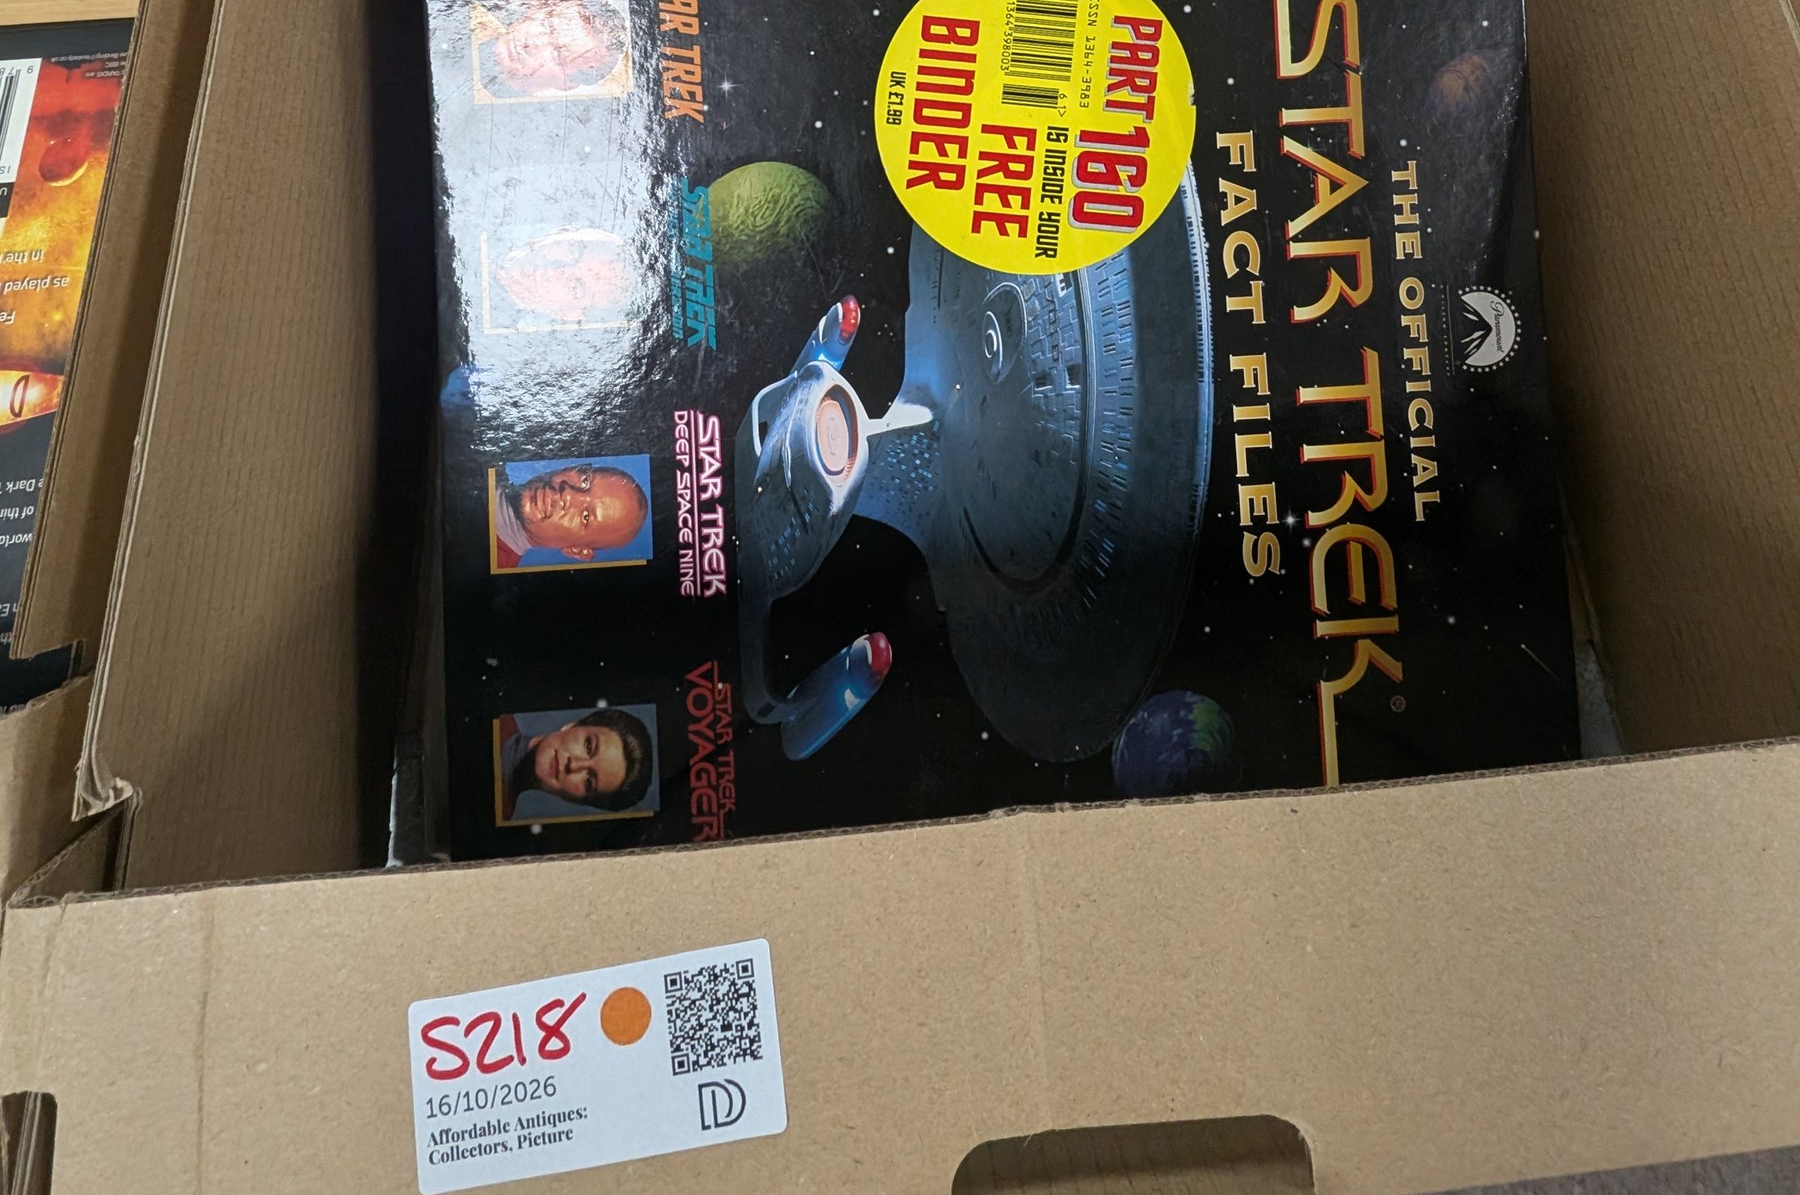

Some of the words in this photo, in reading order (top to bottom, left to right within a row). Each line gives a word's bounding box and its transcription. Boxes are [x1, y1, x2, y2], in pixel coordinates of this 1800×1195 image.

[661, 36, 705, 123] TREK
[889, 70, 907, 88] UK
[906, 14, 981, 191] BINDER
[1079, 35, 1096, 108] 1364-3983
[1103, 14, 1164, 124] PART
[886, 90, 905, 126] £1.99
[1046, 125, 1069, 144] IS
[971, 123, 1037, 238] FREE
[1040, 149, 1067, 205] INSIDE
[1068, 125, 1151, 234] 160
[1391, 161, 1423, 260] THE
[681, 176, 713, 262] STAR
[1035, 211, 1061, 259] YOUR
[1216, 130, 1267, 325] FACT
[4, 276, 51, 295] played
[6, 252, 28, 264] the
[31, 249, 44, 263] in
[53, 276, 69, 288] as
[685, 265, 717, 351] TREK
[1490, 300, 1505, 353] Paramount
[1399, 275, 1441, 521] OFFICIAL
[674, 411, 691, 466] DEEP
[698, 412, 724, 499] STAR
[1229, 352, 1282, 578] FILES
[6, 479, 36, 494] Dark
[21, 506, 34, 519] of
[676, 470, 693, 541] SPACE
[679, 545, 695, 597] NINE
[701, 505, 727, 597] TREK
[1296, 346, 1404, 789] TREK
[714, 660, 733, 744] STAR
[685, 661, 721, 841] VOYAGER
[718, 750, 736, 839] TREK
[420, 991, 587, 1081] S218
[425, 1075, 557, 1119] 16/10/2026
[427, 1119, 511, 1148] Affordable
[514, 1106, 589, 1134] Antiques:
[428, 1139, 514, 1165] Collectors,
[517, 1127, 574, 1151] Picture
